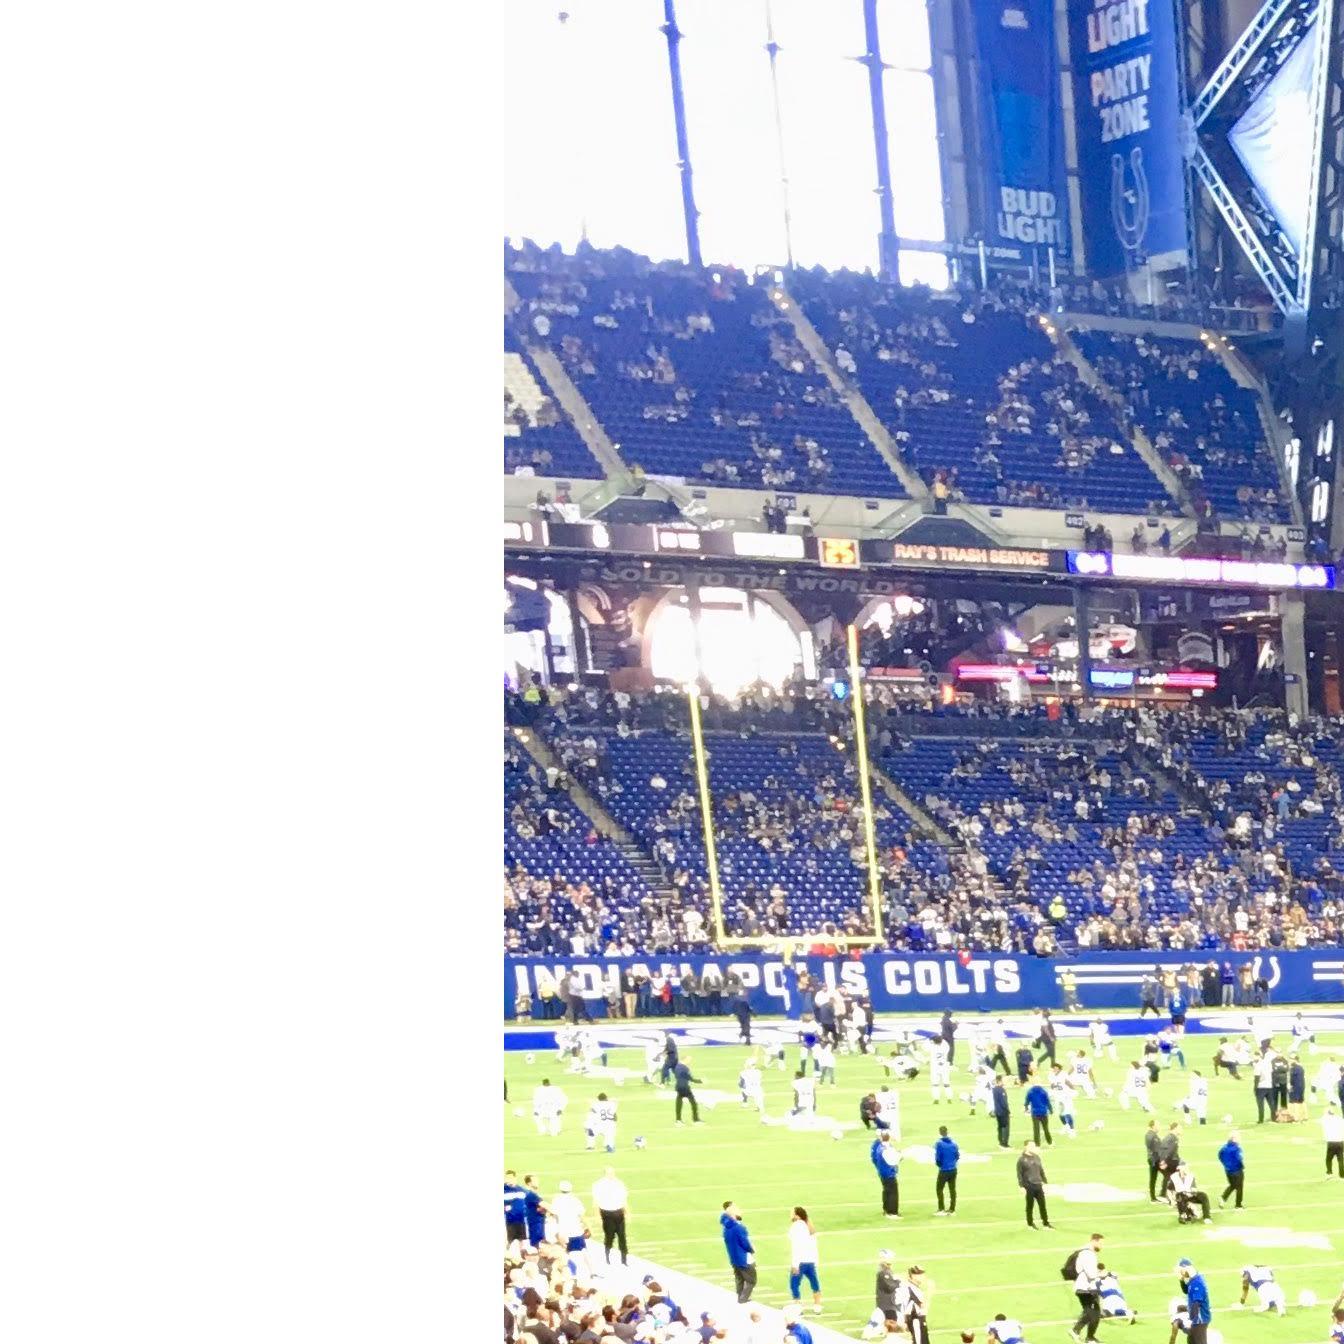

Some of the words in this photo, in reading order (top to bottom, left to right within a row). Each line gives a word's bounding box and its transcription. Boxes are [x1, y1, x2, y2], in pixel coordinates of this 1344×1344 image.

[1086, 0, 1150, 53] LIGHT
[1091, 53, 1151, 107] PARTY
[1100, 95, 1150, 143] ZONE
[1001, 186, 1056, 217] BUD
[998, 212, 1063, 243] LIGHT
[895, 543, 936, 561] RAY'S
[938, 547, 987, 563] TRASH
[990, 550, 1050, 567] SERVICE
[884, 960, 1021, 995] COLTS
